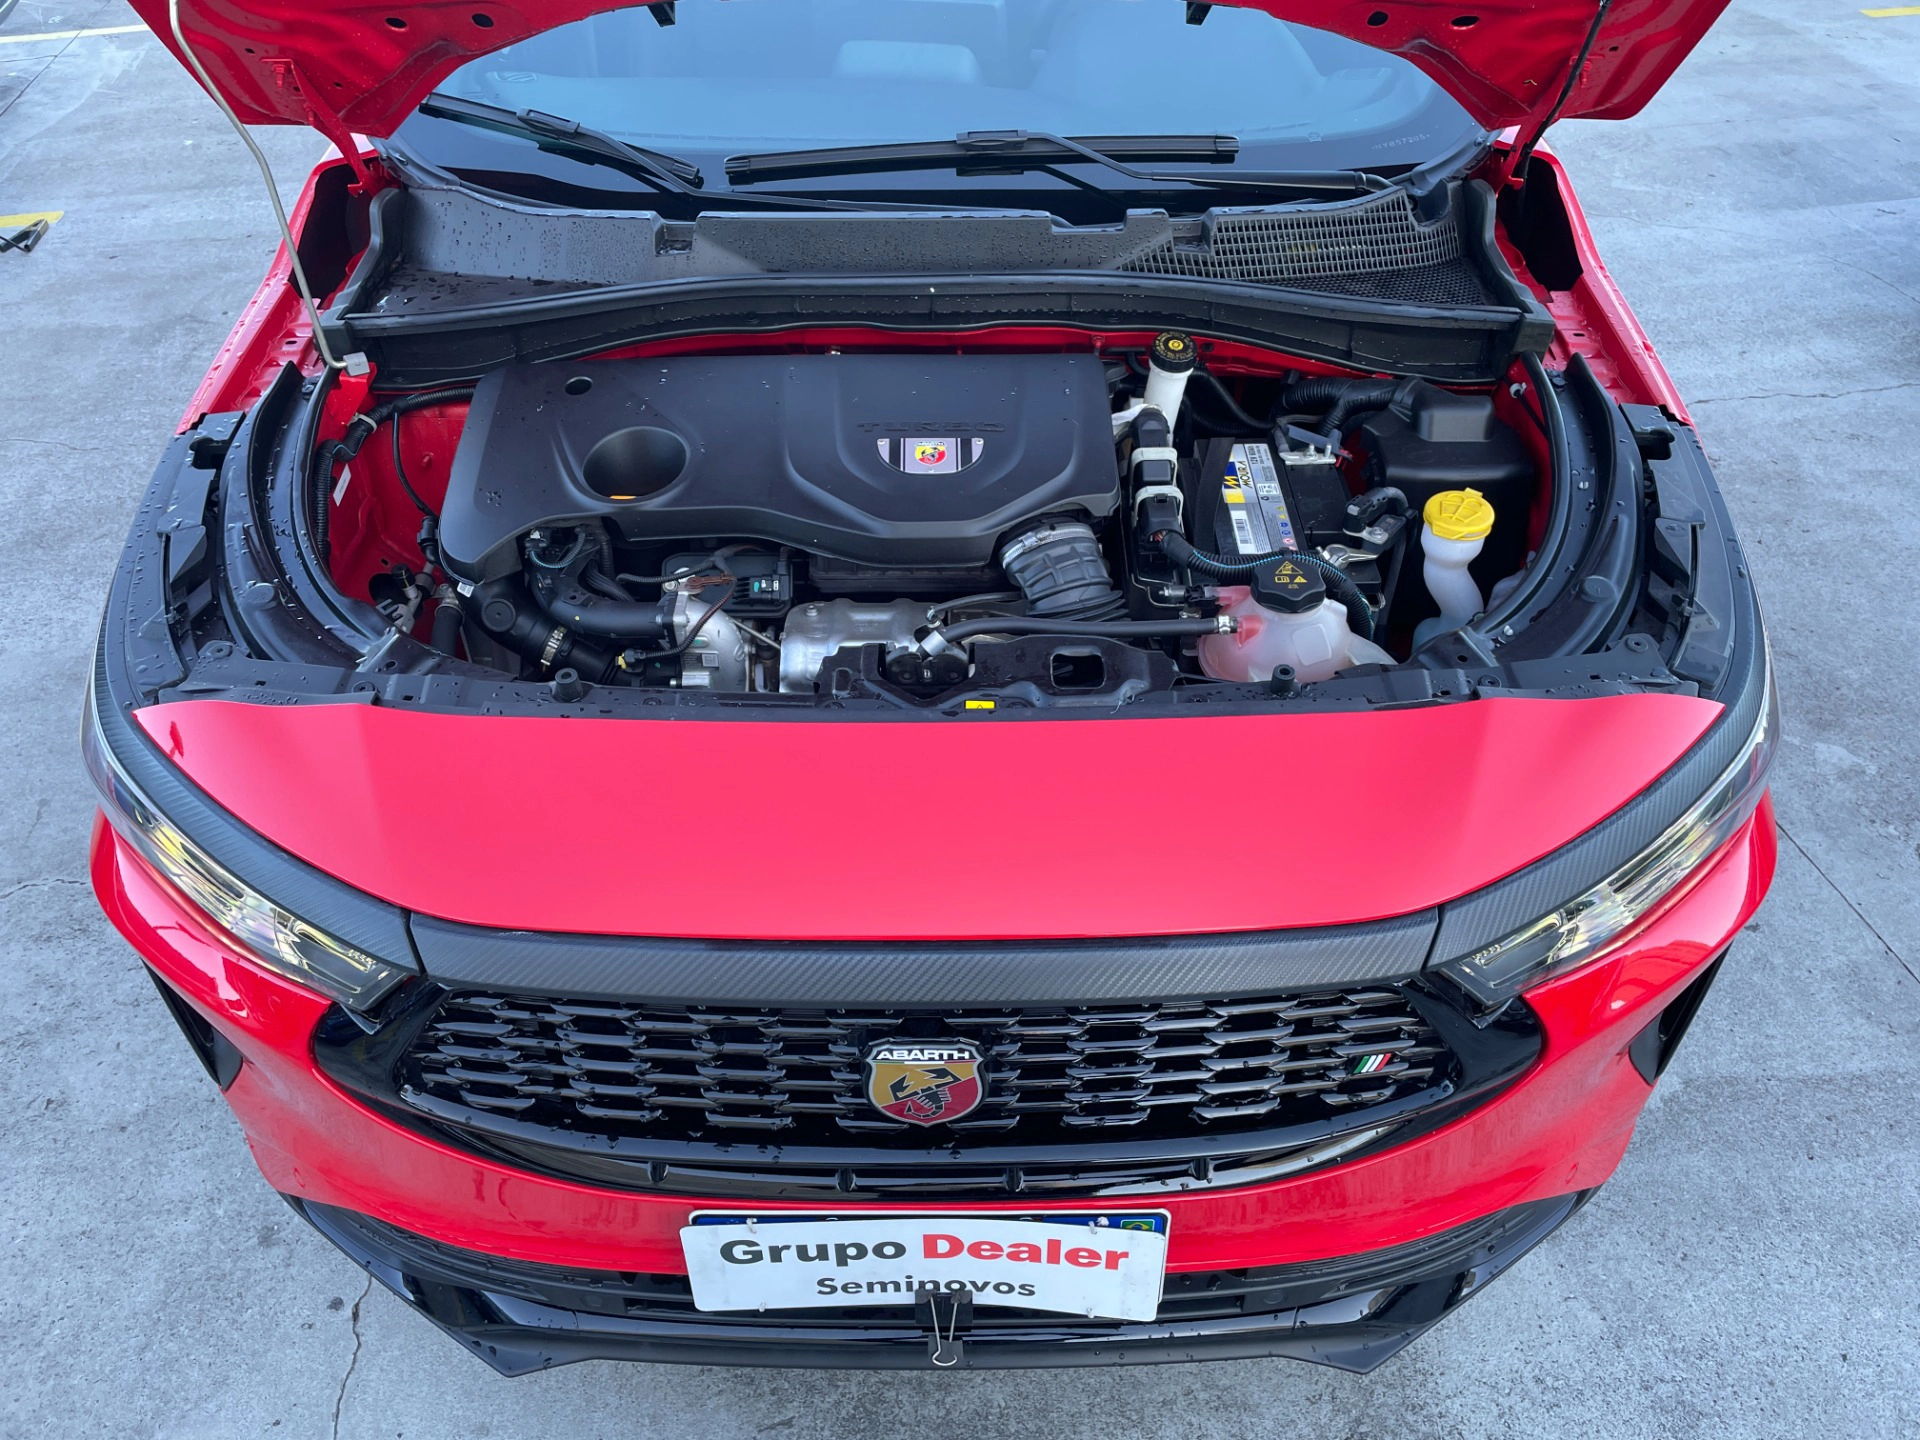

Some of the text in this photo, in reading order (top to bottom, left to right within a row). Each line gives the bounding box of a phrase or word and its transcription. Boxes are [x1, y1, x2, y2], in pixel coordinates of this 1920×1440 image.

[857, 420, 1006, 433] TURBO
[1237, 460, 1253, 489] MOURA
[876, 1049, 970, 1060] ABARTH
[719, 1233, 1129, 1271] Grupo Dealer
[816, 1275, 1036, 1297] Seminovos
